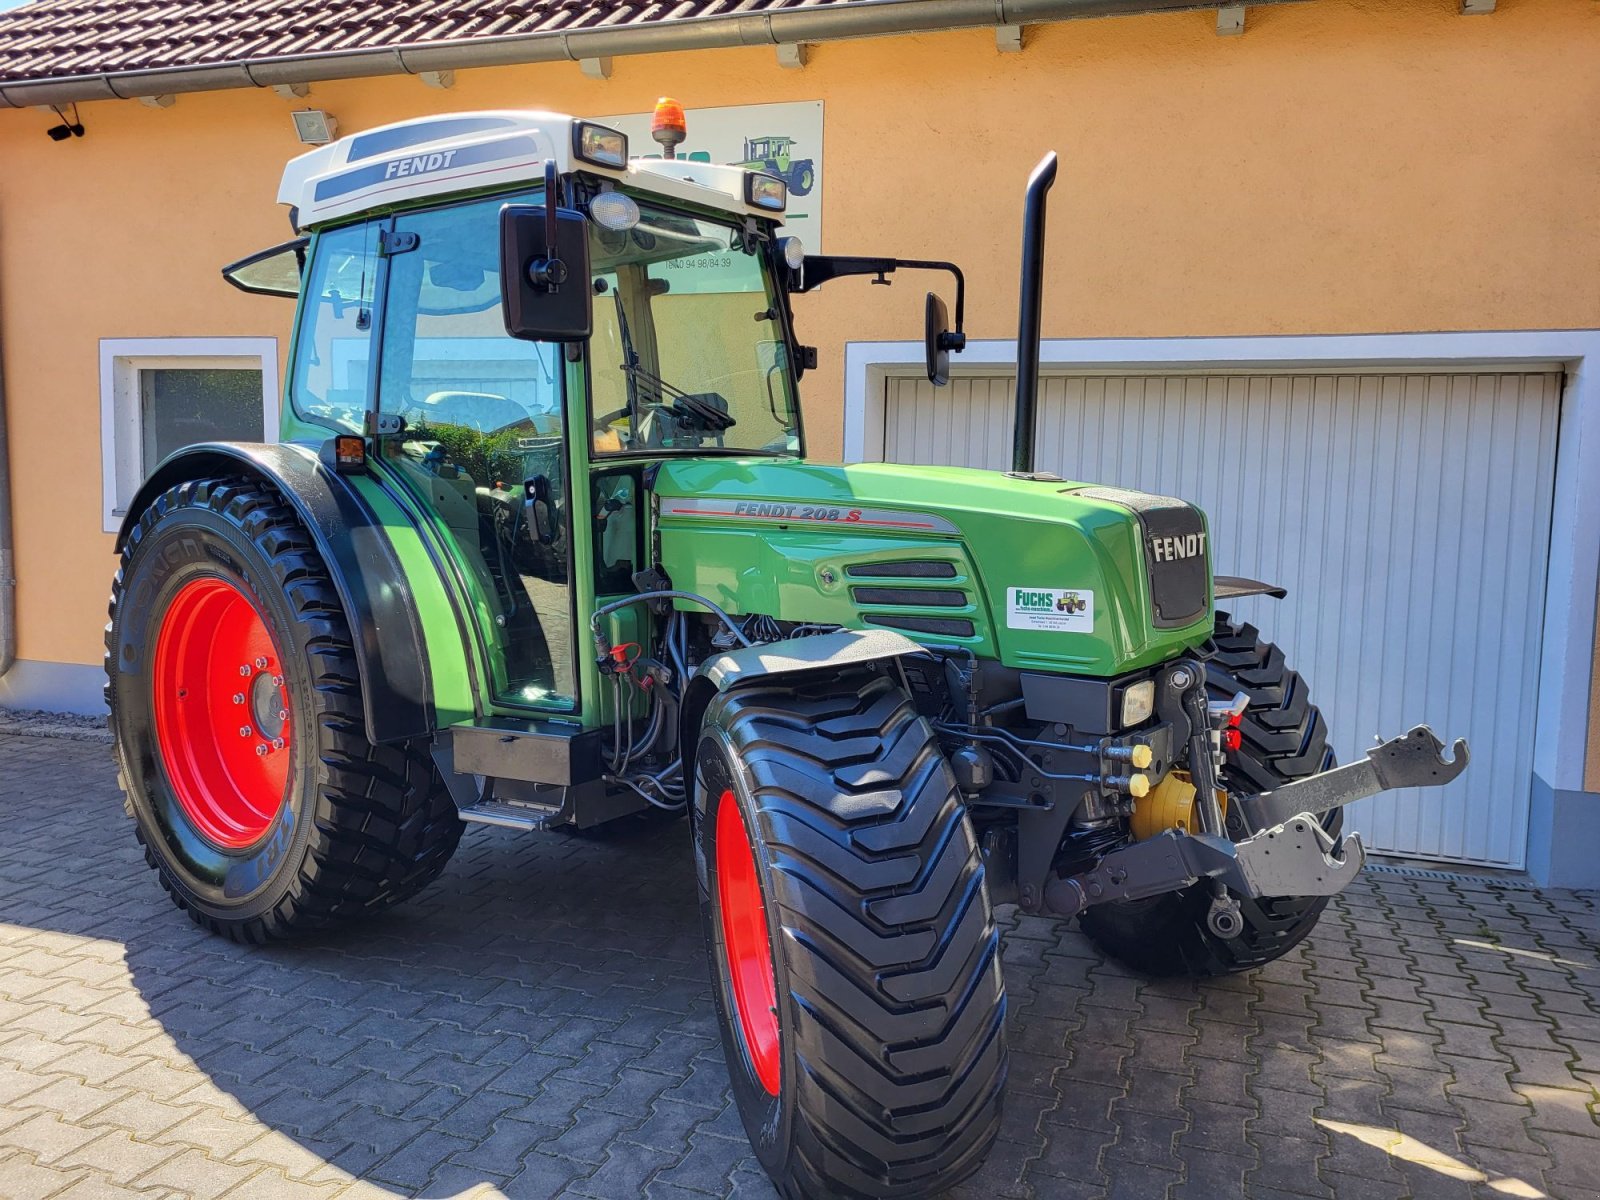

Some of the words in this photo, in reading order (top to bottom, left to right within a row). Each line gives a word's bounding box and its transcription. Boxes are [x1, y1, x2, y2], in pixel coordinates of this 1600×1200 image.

[385, 150, 456, 179] FENDT
[721, 258, 731, 267] 39
[735, 502, 796, 518] FENDT
[800, 507, 839, 520] 208
[846, 510, 862, 521] S
[1153, 533, 1206, 562] FENDT
